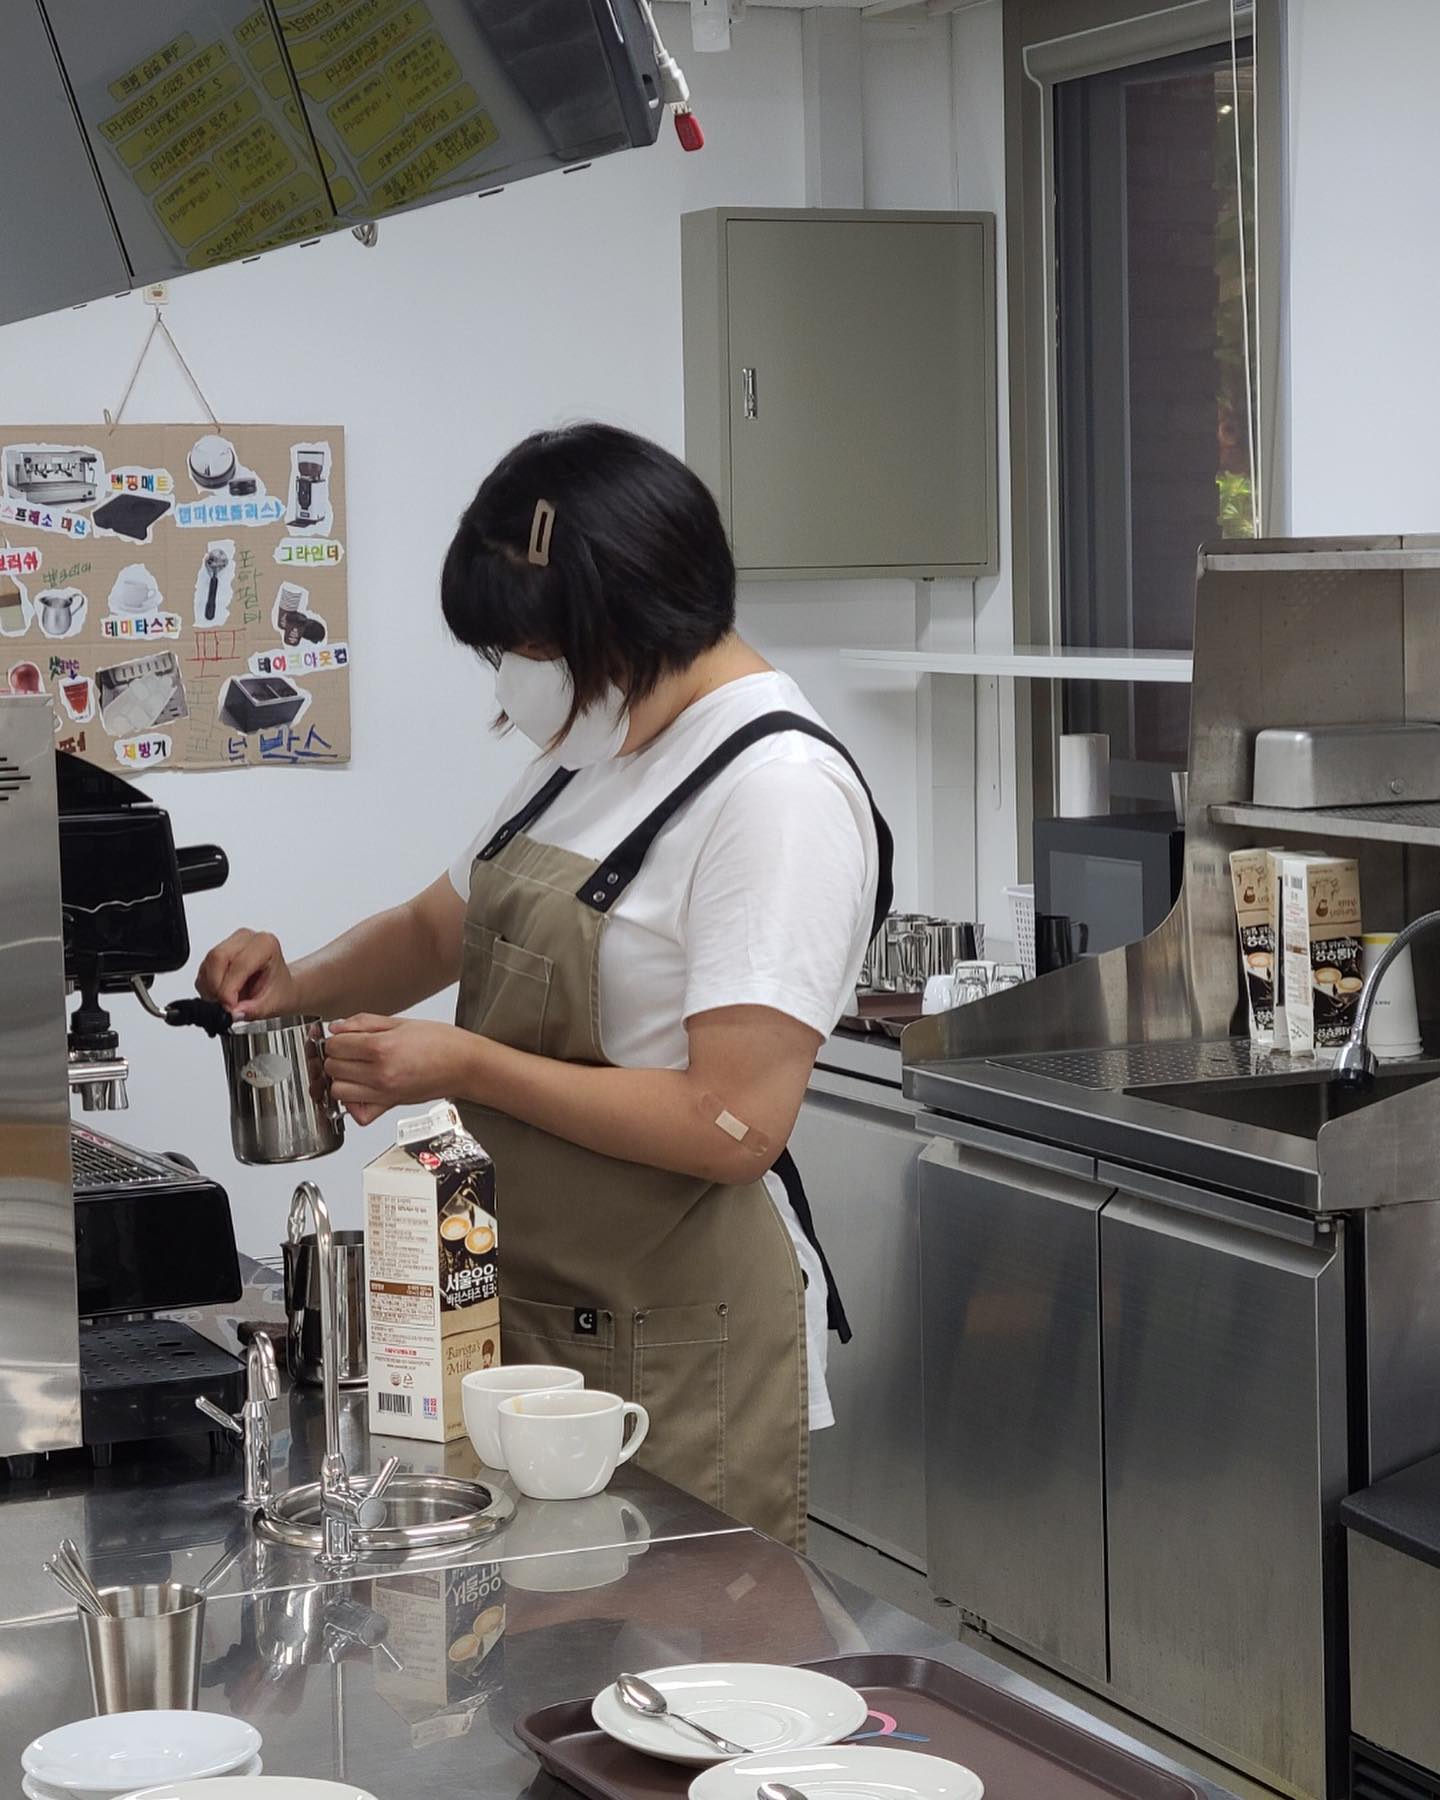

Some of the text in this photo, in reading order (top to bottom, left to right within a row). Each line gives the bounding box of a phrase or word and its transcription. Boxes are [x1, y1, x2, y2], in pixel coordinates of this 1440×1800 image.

[282, 545, 339, 562] 그라인더
[123, 740, 167, 760] 제빙기
[445, 1263, 495, 1292] 서울우유
